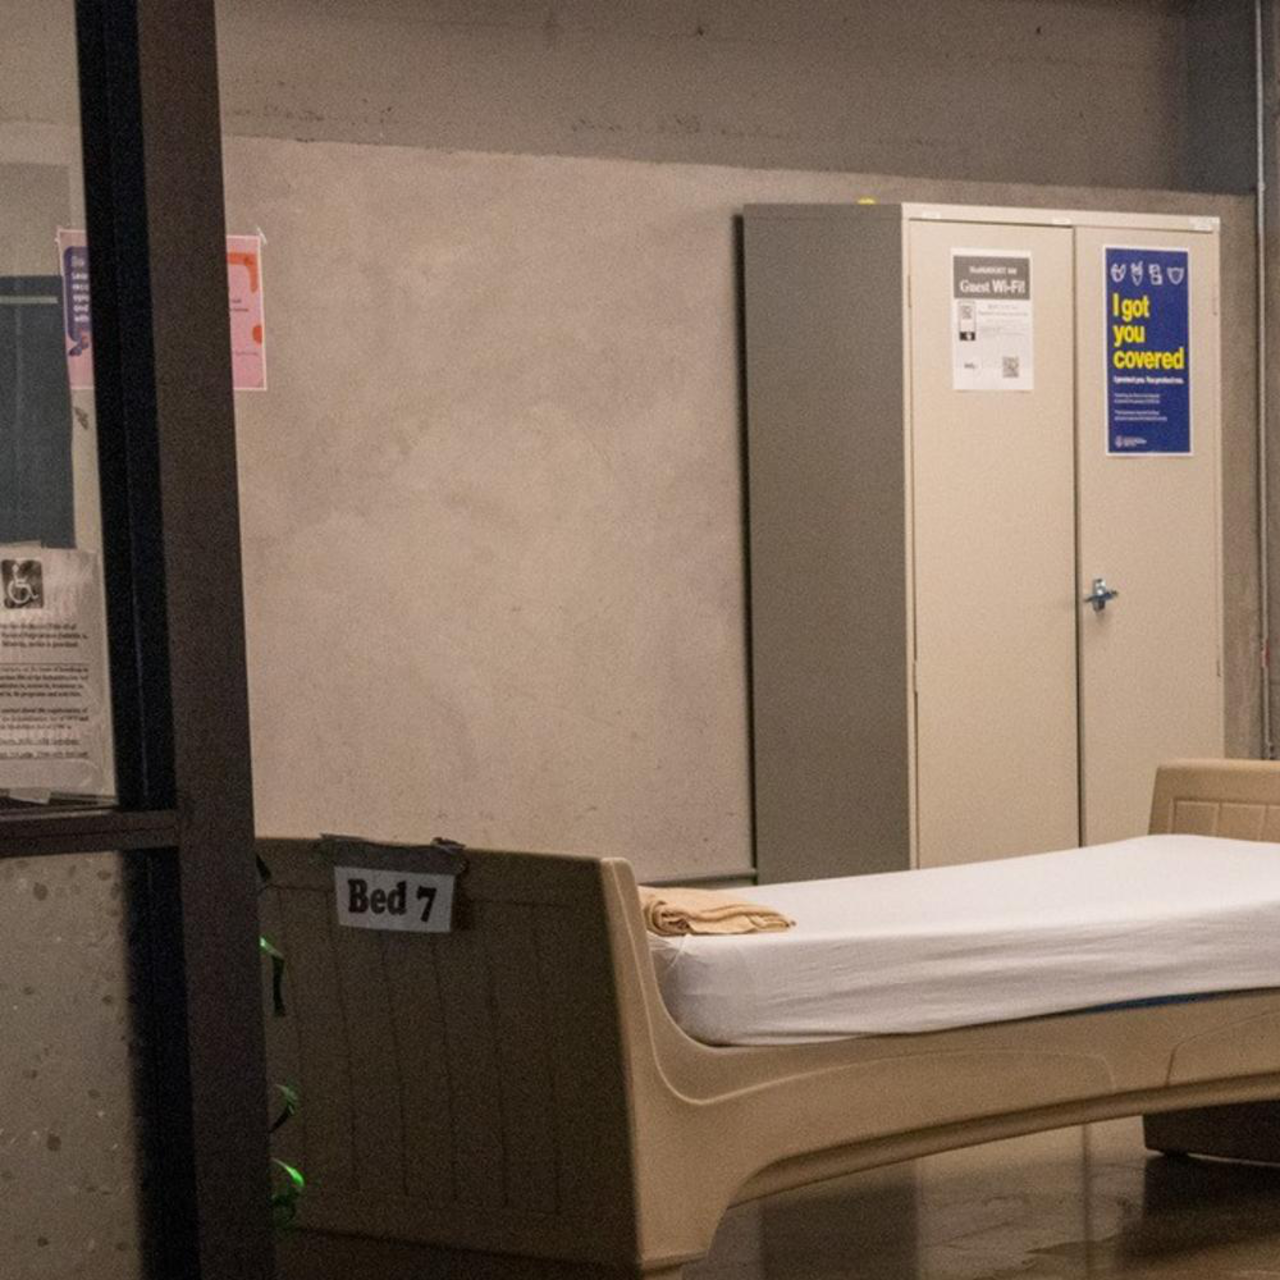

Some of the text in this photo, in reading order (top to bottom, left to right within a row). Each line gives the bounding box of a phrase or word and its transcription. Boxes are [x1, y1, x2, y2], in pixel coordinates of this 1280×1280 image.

[1113, 292, 1150, 322] I got
[1113, 324, 1146, 347] you
[1113, 346, 1185, 369] covered
[347, 878, 438, 922] Bed 7
